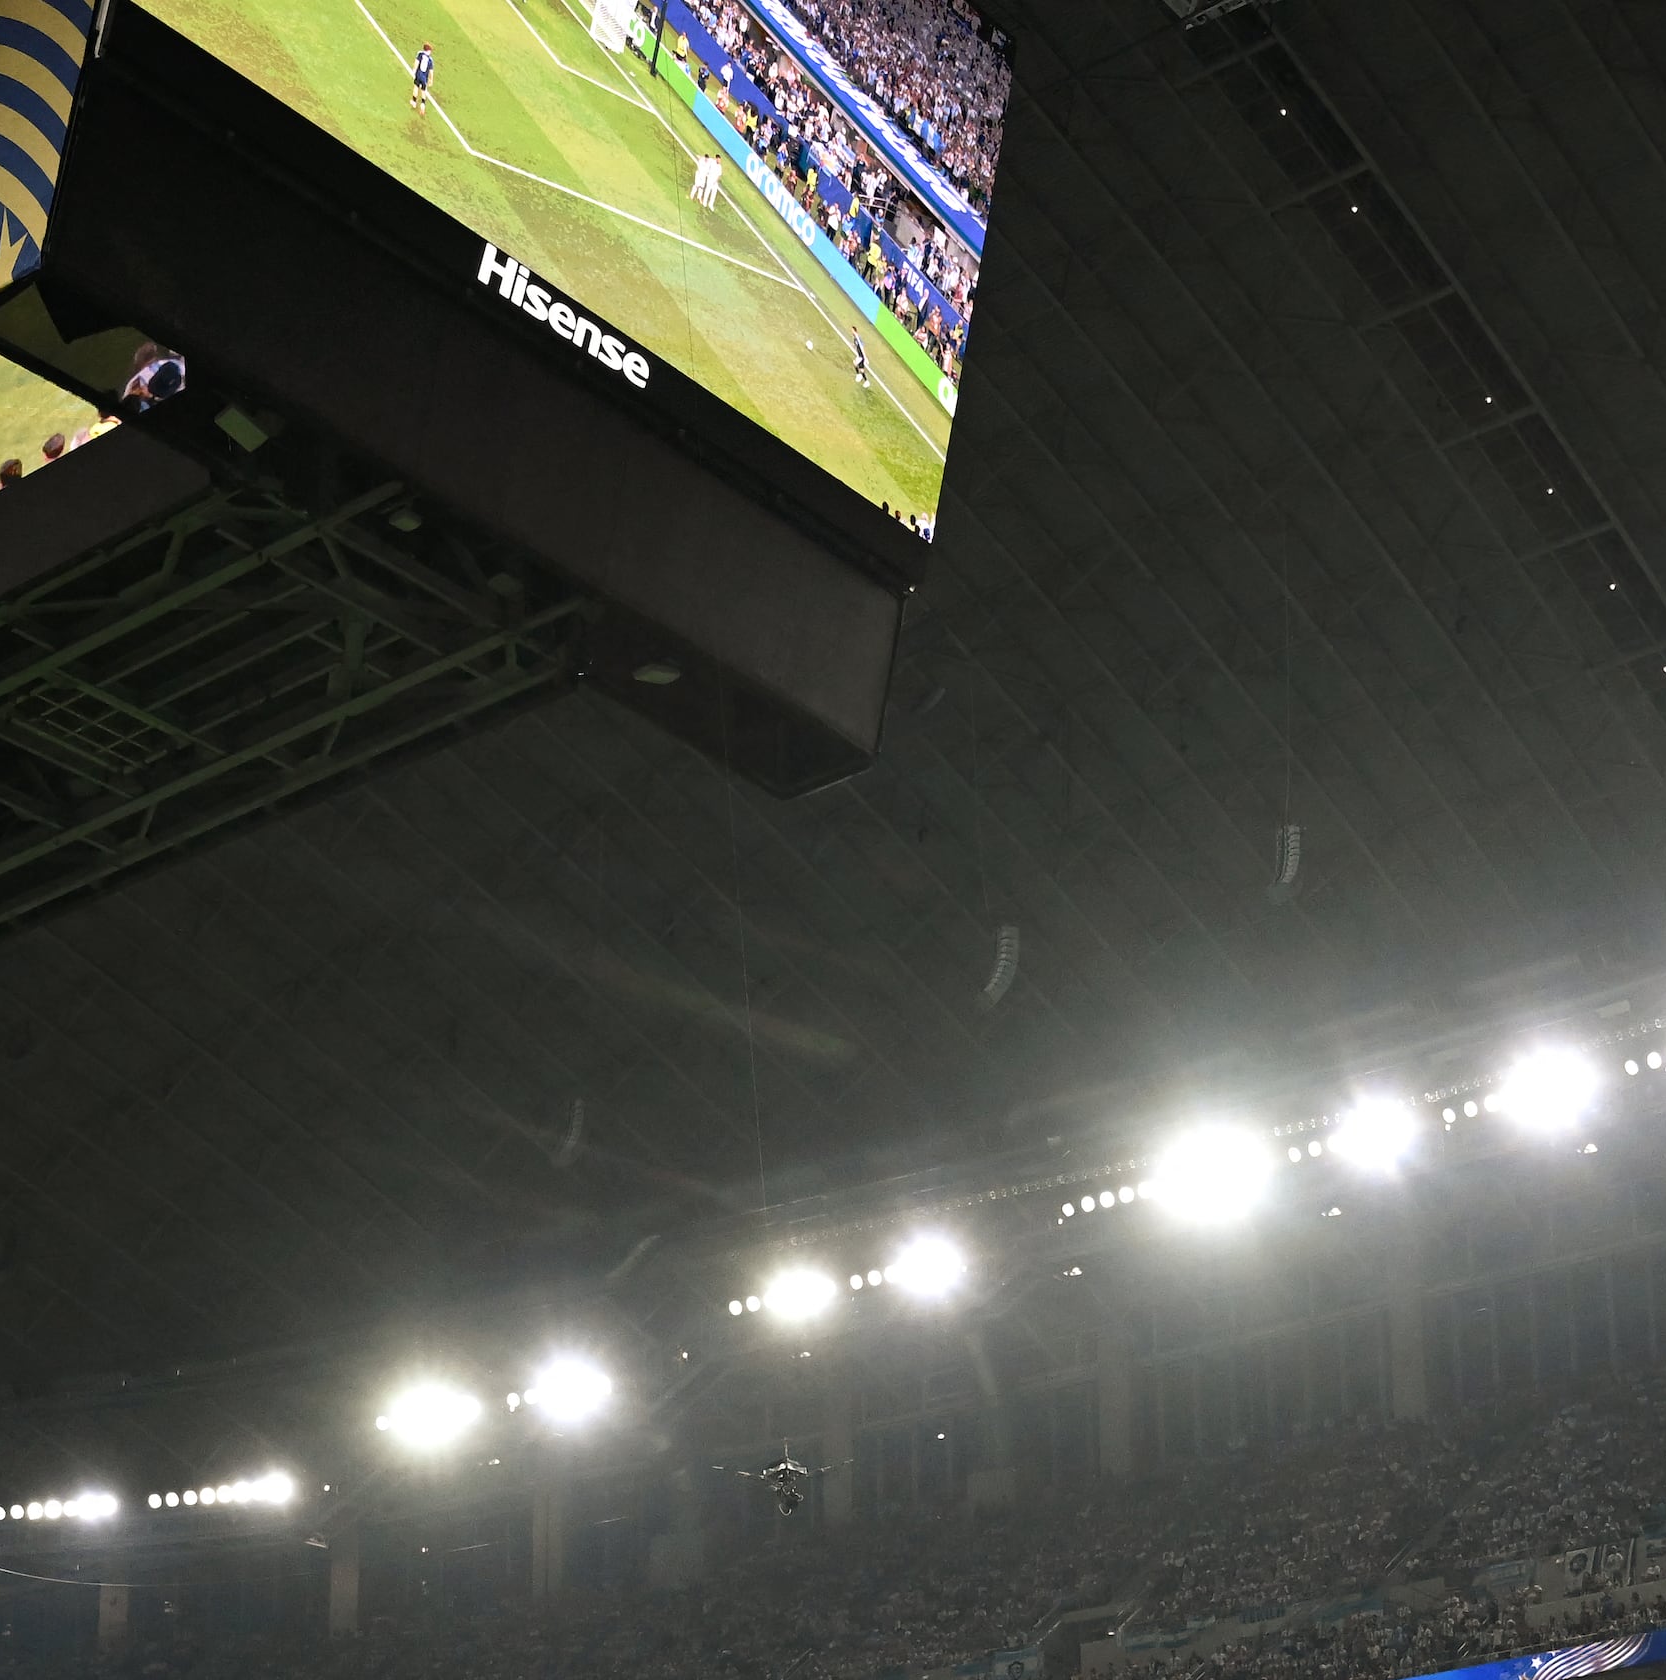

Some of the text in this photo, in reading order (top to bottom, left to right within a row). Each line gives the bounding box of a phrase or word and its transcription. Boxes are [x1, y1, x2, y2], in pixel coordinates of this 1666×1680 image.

[745, 152, 816, 247] aramco
[476, 242, 650, 389] Hisense
[903, 260, 925, 298] FIFA
